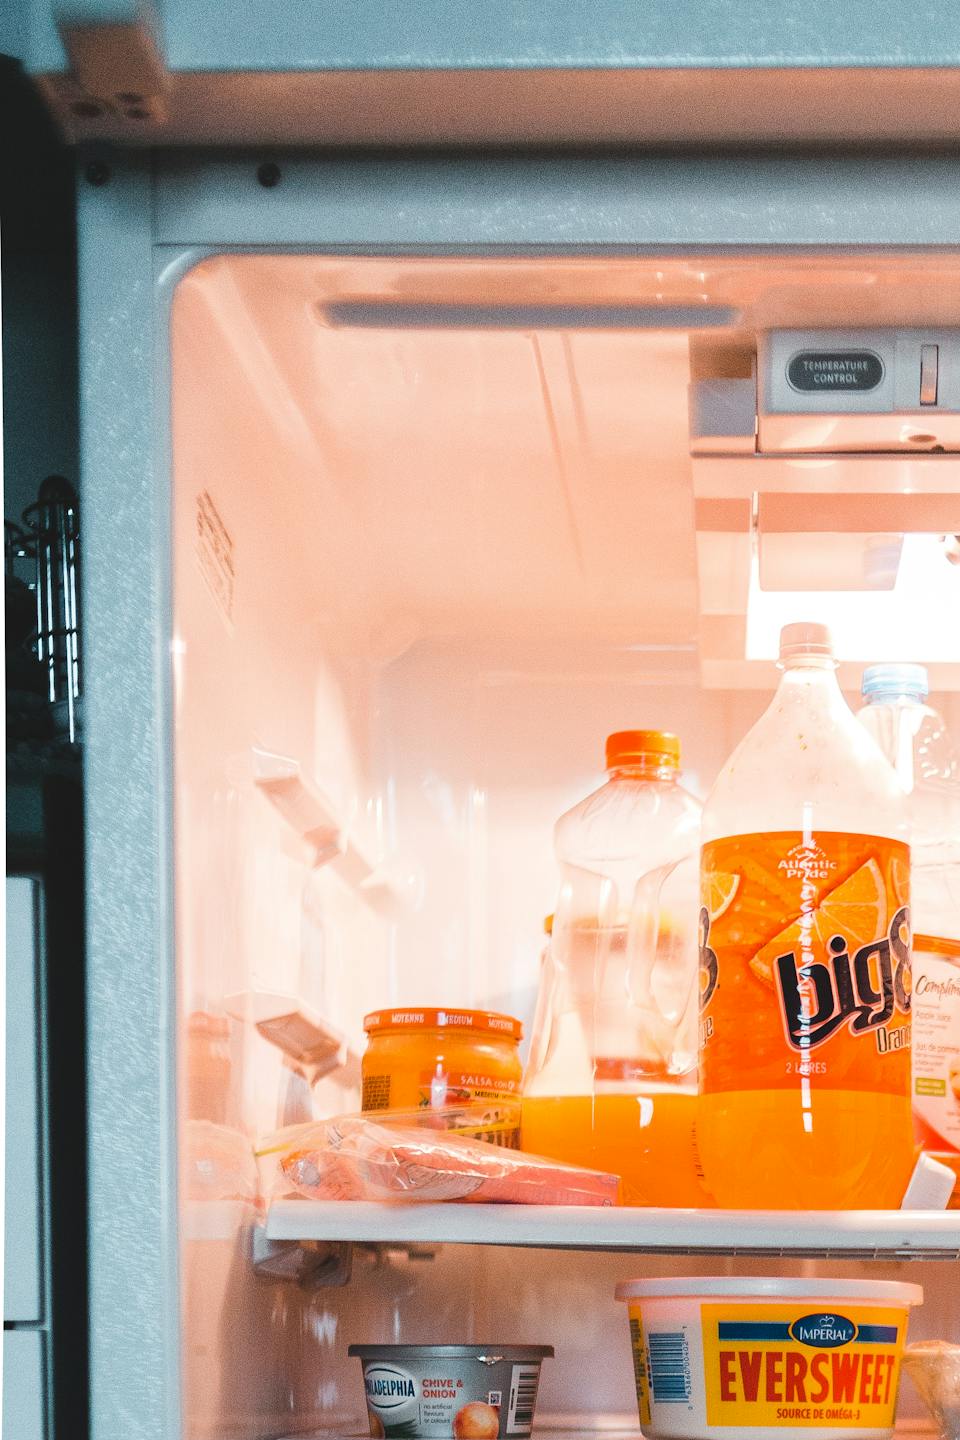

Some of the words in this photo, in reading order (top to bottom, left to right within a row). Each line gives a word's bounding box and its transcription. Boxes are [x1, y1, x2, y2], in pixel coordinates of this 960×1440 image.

[803, 360, 869, 371] TEMPERATURE
[813, 373, 858, 383] CONTROL
[786, 1062, 792, 1073] 2
[794, 1062, 827, 1074] LRES
[461, 1075, 492, 1088] SALSA
[799, 1326, 849, 1341] IMPERIAL
[422, 1379, 453, 1388] CHIVE
[456, 1379, 464, 1388] &
[720, 1351, 896, 1405] EVERSWEET
[422, 1390, 456, 1399] ONION
[776, 1408, 811, 1420] SOURCE
[813, 1408, 825, 1420] DE
